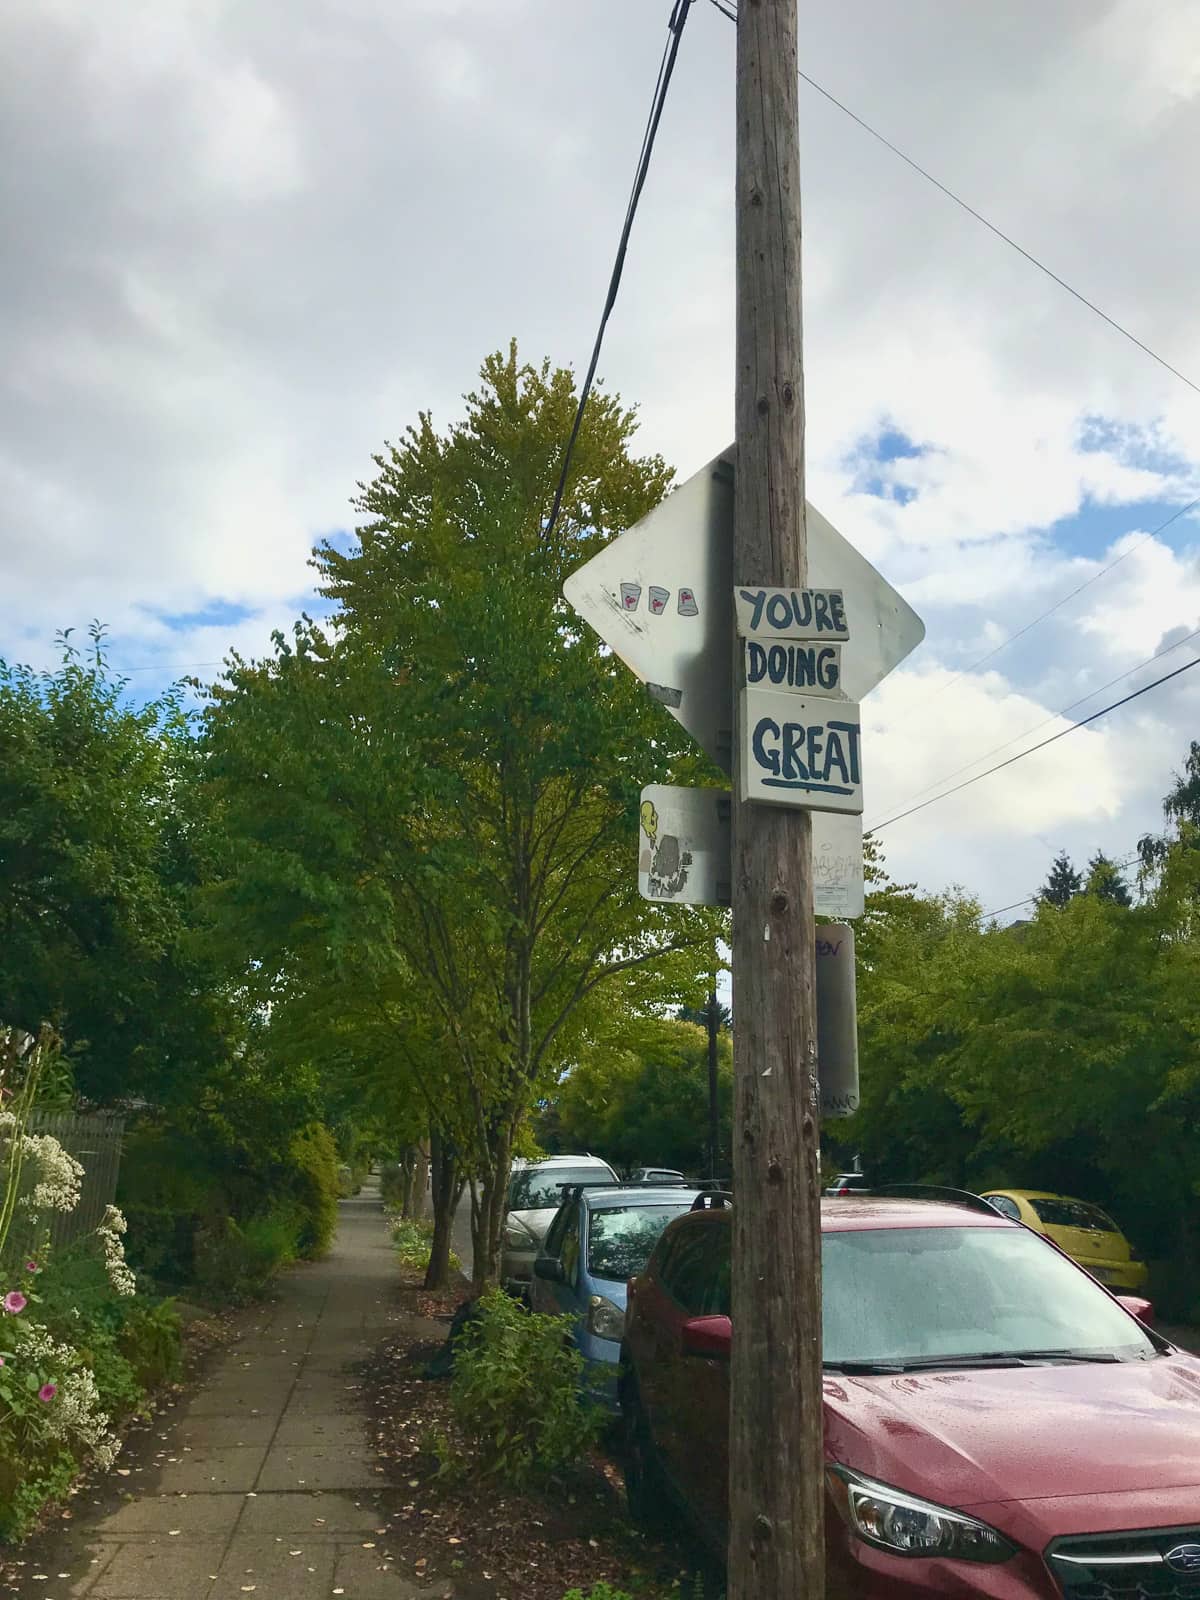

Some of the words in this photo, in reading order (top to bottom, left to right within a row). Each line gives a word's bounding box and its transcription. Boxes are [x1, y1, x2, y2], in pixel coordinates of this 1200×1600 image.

[740, 590, 847, 632] YOU'RE
[748, 642, 839, 689] DOING
[754, 717, 860, 785] GREAT
